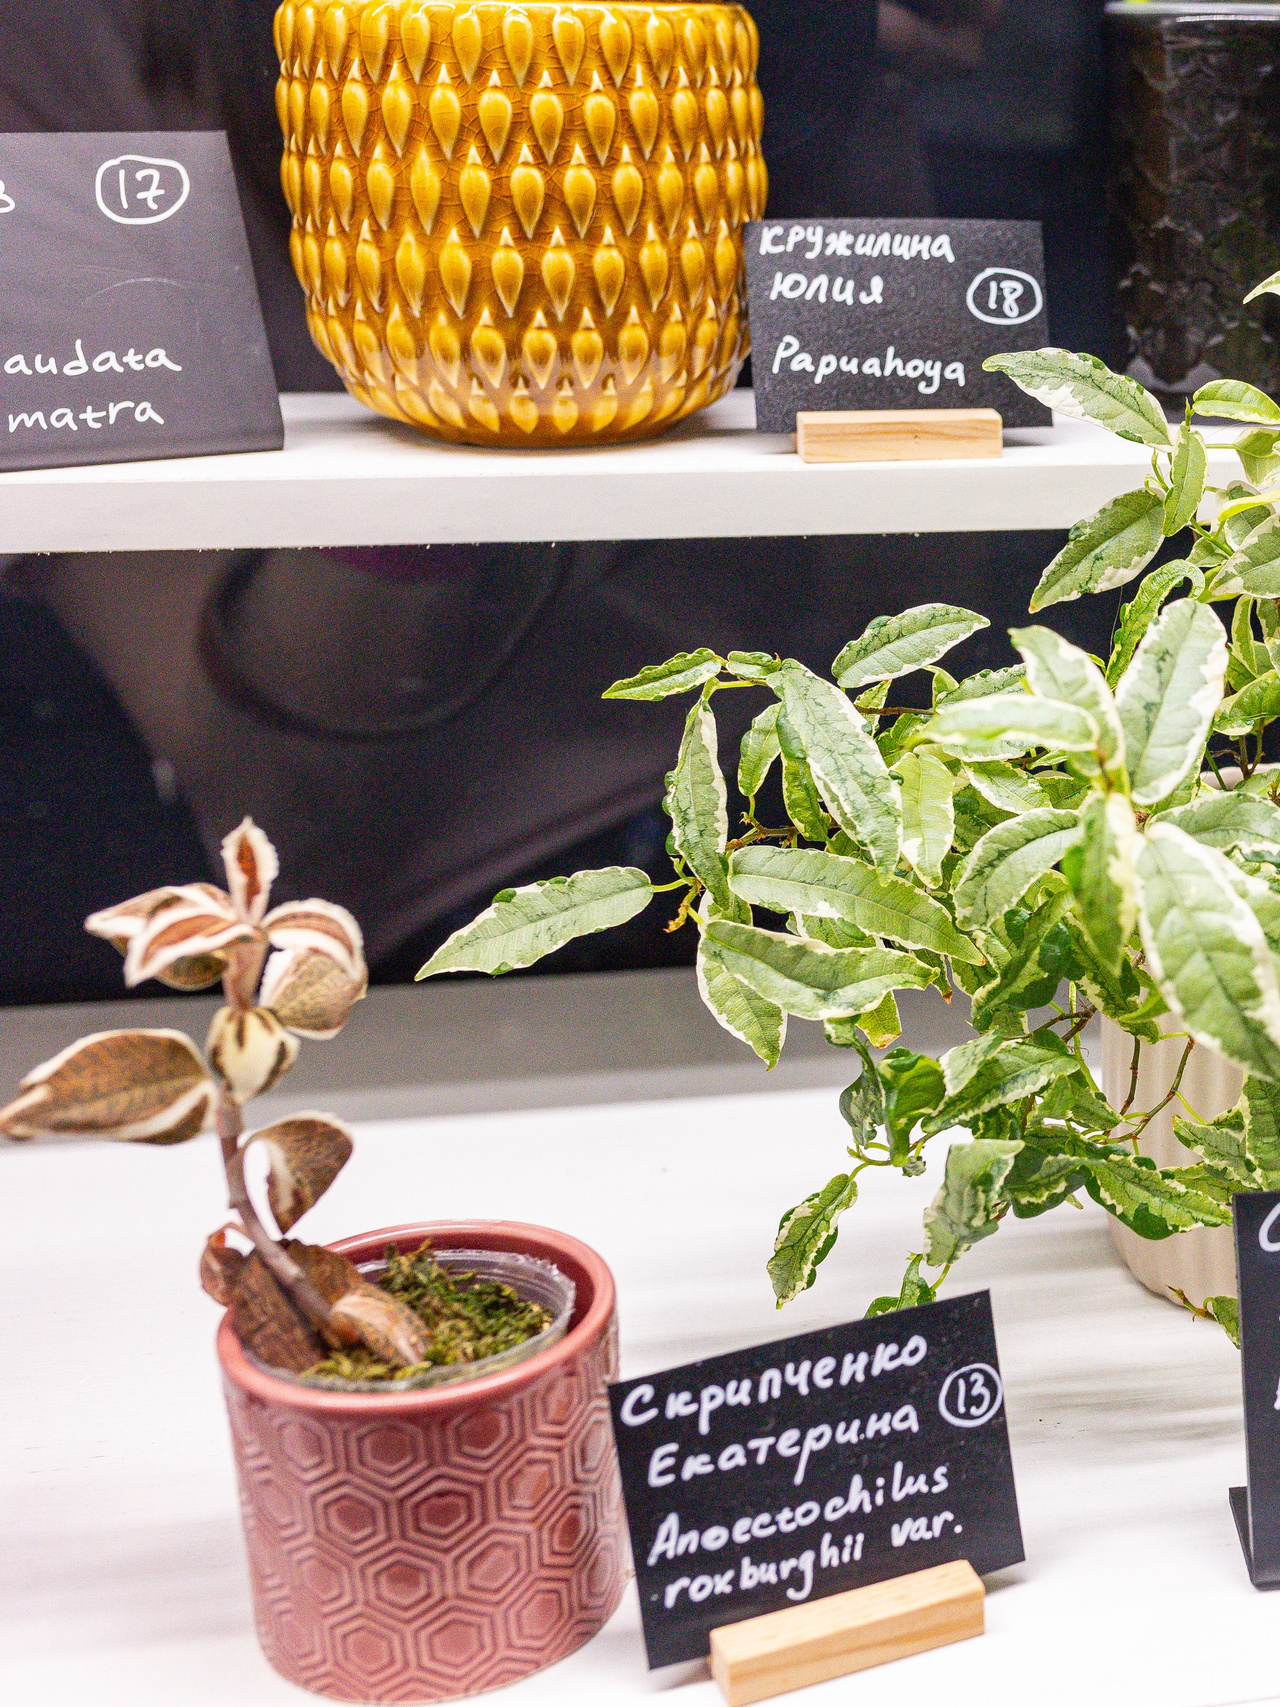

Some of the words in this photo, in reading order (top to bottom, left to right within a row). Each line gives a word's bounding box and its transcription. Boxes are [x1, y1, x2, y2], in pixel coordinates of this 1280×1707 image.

[119, 168, 165, 210] 17
[769, 271, 884, 305] Юлия
[988, 281, 1023, 318] 18
[1, 339, 182, 376] audata
[772, 335, 965, 394] Papuahoya
[8, 401, 164, 432] matra
[620, 1335, 928, 1435] Скрипченко
[956, 1372, 991, 1416] 13
[647, 1404, 919, 1487] Екатерина
[647, 1461, 949, 1567] Anoectochilus
[664, 1532, 864, 1609] roxburghii
[890, 1511, 963, 1548] var.
